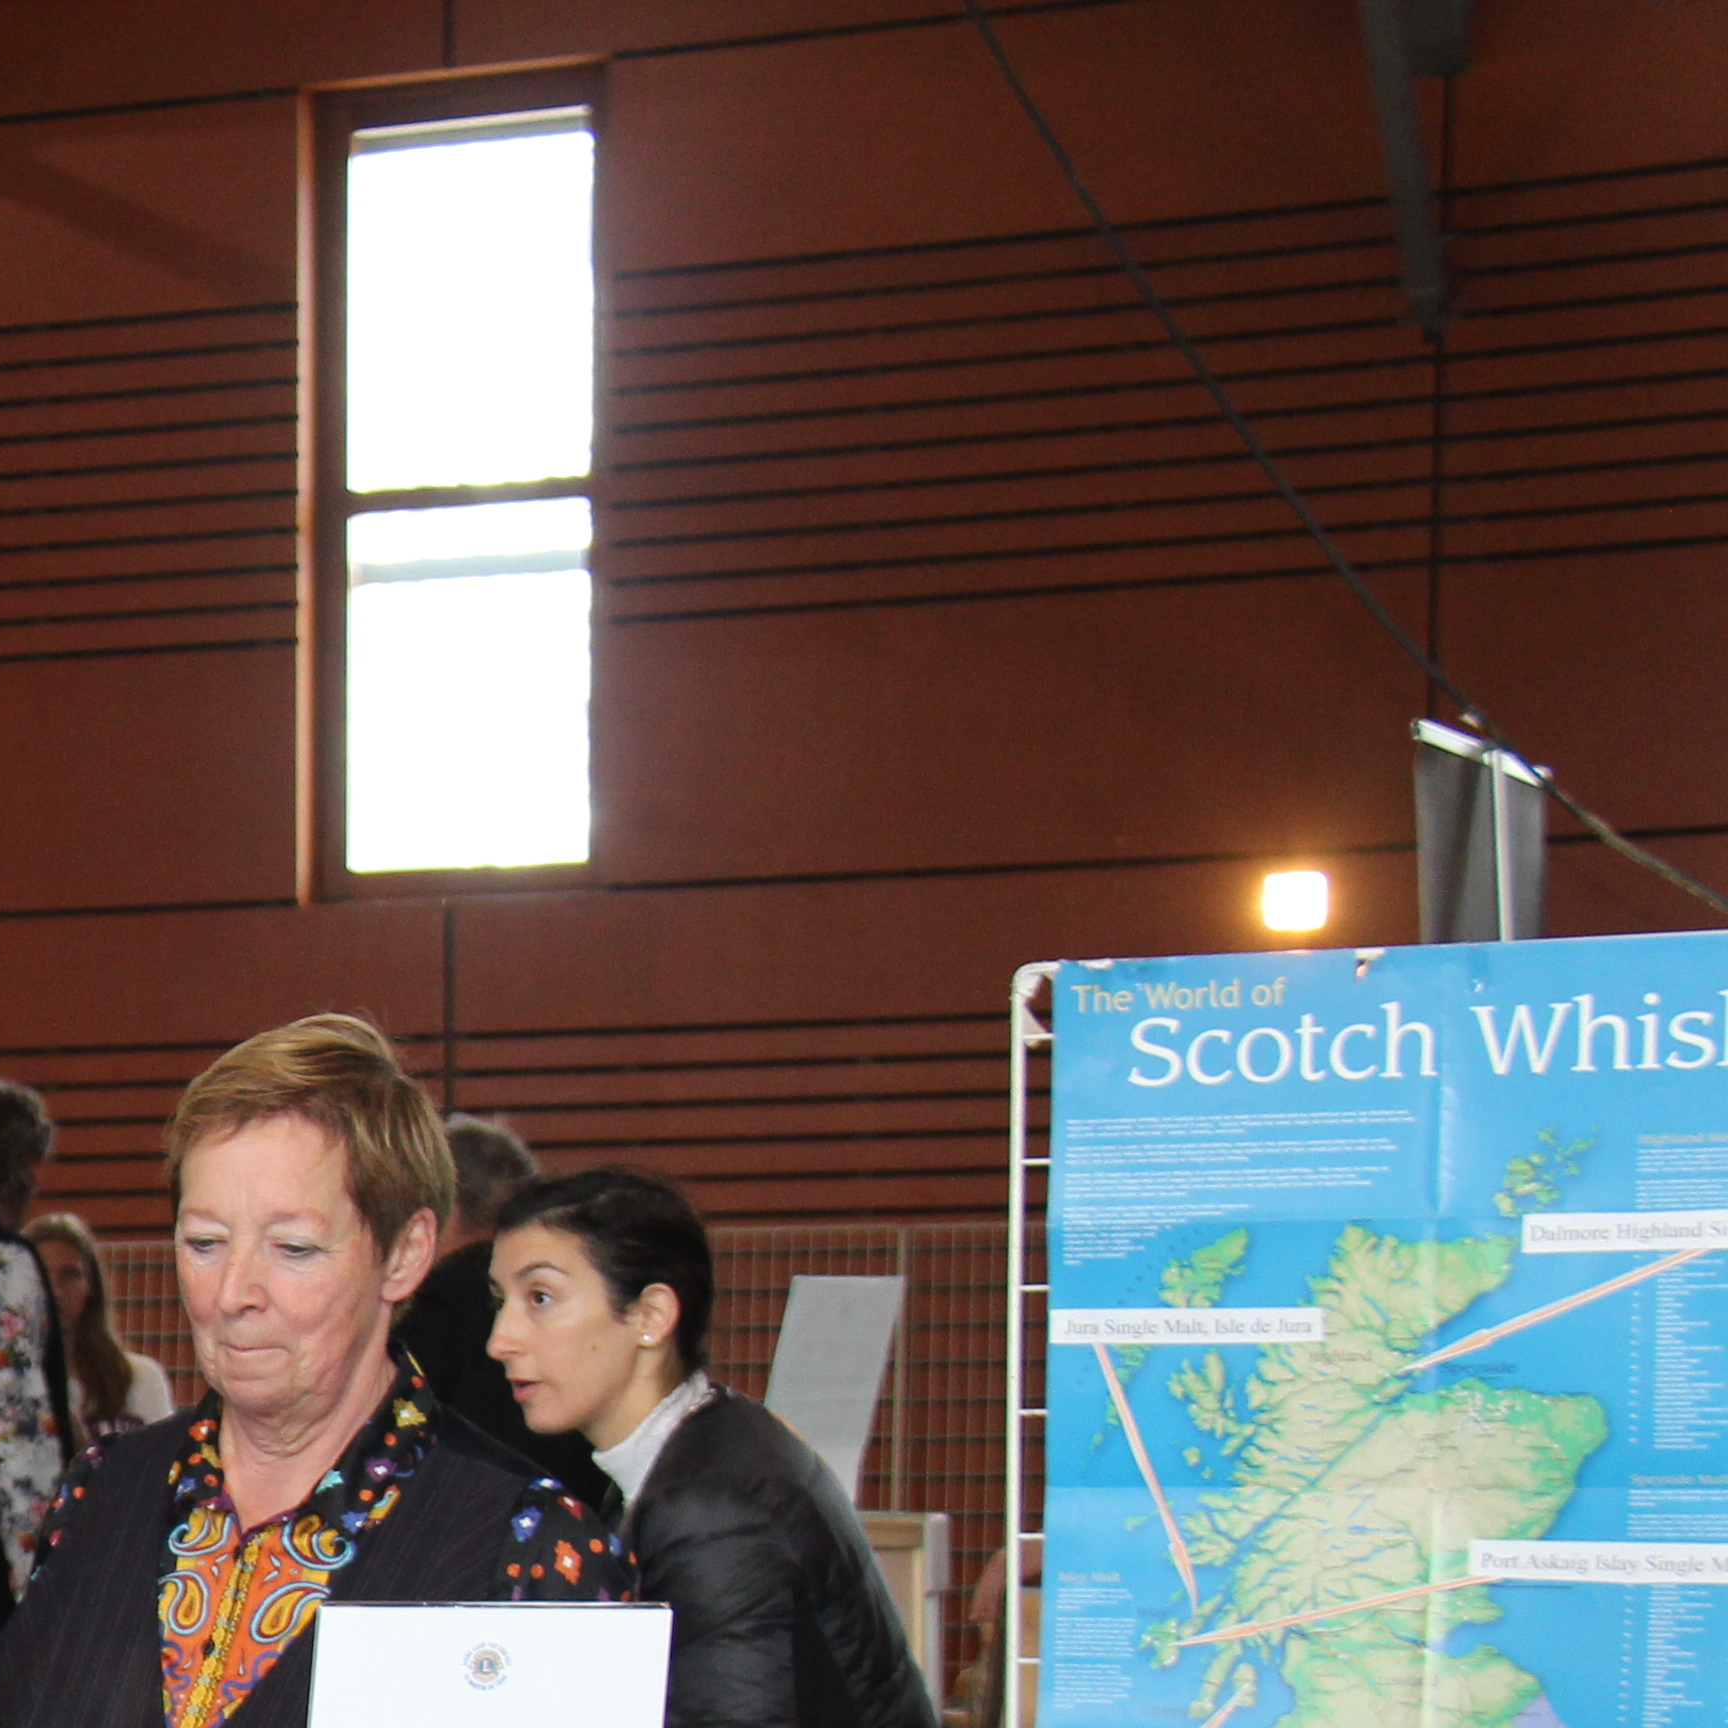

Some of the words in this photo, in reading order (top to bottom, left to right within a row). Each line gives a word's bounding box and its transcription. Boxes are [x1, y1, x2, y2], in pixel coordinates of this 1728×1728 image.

[1071, 983, 1135, 1013] The
[1145, 978, 1243, 1010] World
[1251, 976, 1288, 1007] of
[1127, 1001, 1438, 1087] Scotch
[1530, 1224, 1610, 1242] Dalmore
[1616, 1221, 1702, 1243] Highland
[1064, 1319, 1099, 1335] Jura
[1104, 1319, 1157, 1338] Single
[1163, 1318, 1208, 1335] Malt,
[1215, 1318, 1245, 1334] Isle
[1250, 1317, 1270, 1334] de
[1276, 1317, 1312, 1334] Jura
[1481, 1553, 1518, 1569] Port
[1524, 1554, 1587, 1574] Askaig
[1596, 1555, 1636, 1574] Islay
[1644, 1556, 1704, 1576] Single
